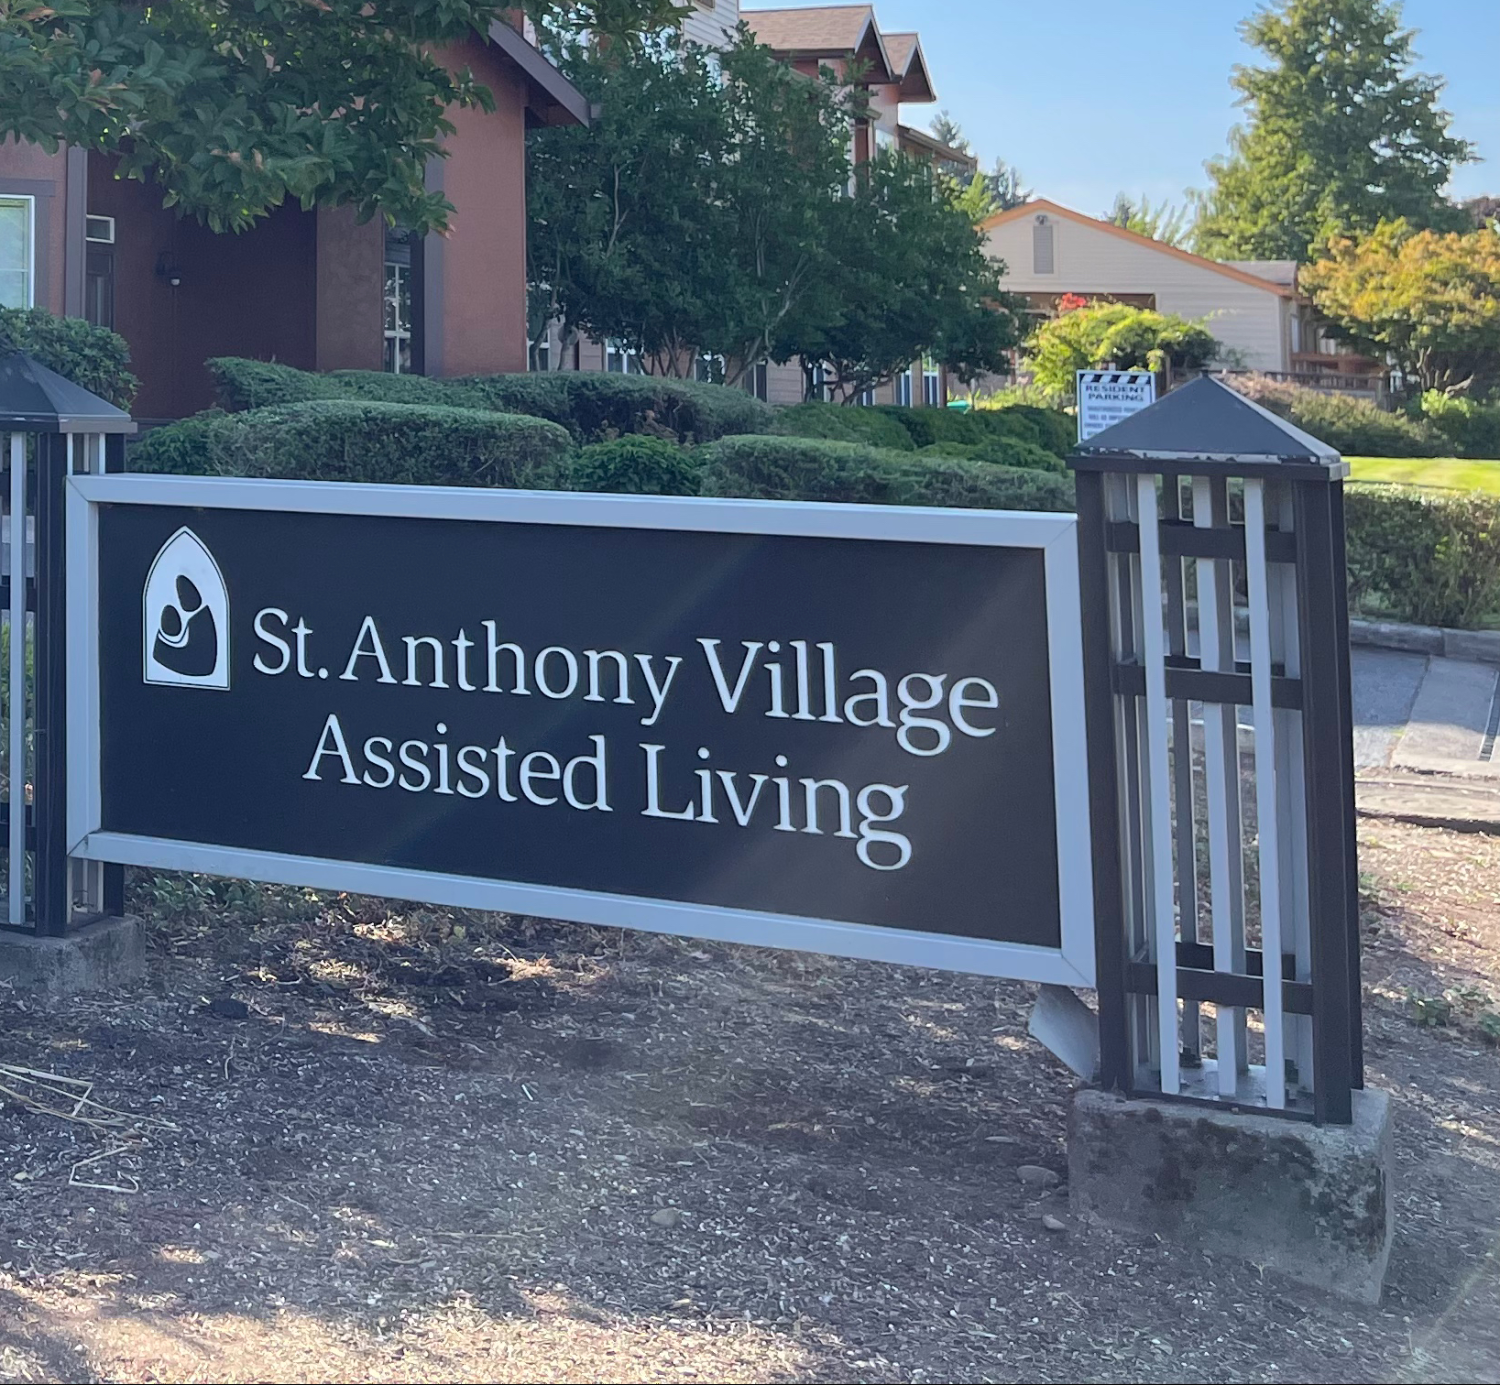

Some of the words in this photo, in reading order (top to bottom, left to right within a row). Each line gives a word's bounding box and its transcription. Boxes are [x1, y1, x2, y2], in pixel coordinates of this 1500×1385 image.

[1085, 385, 1144, 393] RESIDENT
[1088, 393, 1144, 402] PARKING
[252, 606, 329, 680] St.
[338, 615, 684, 726] Anthony
[695, 637, 1000, 758] Village
[301, 713, 614, 812] Assisted
[639, 743, 913, 872] Living
